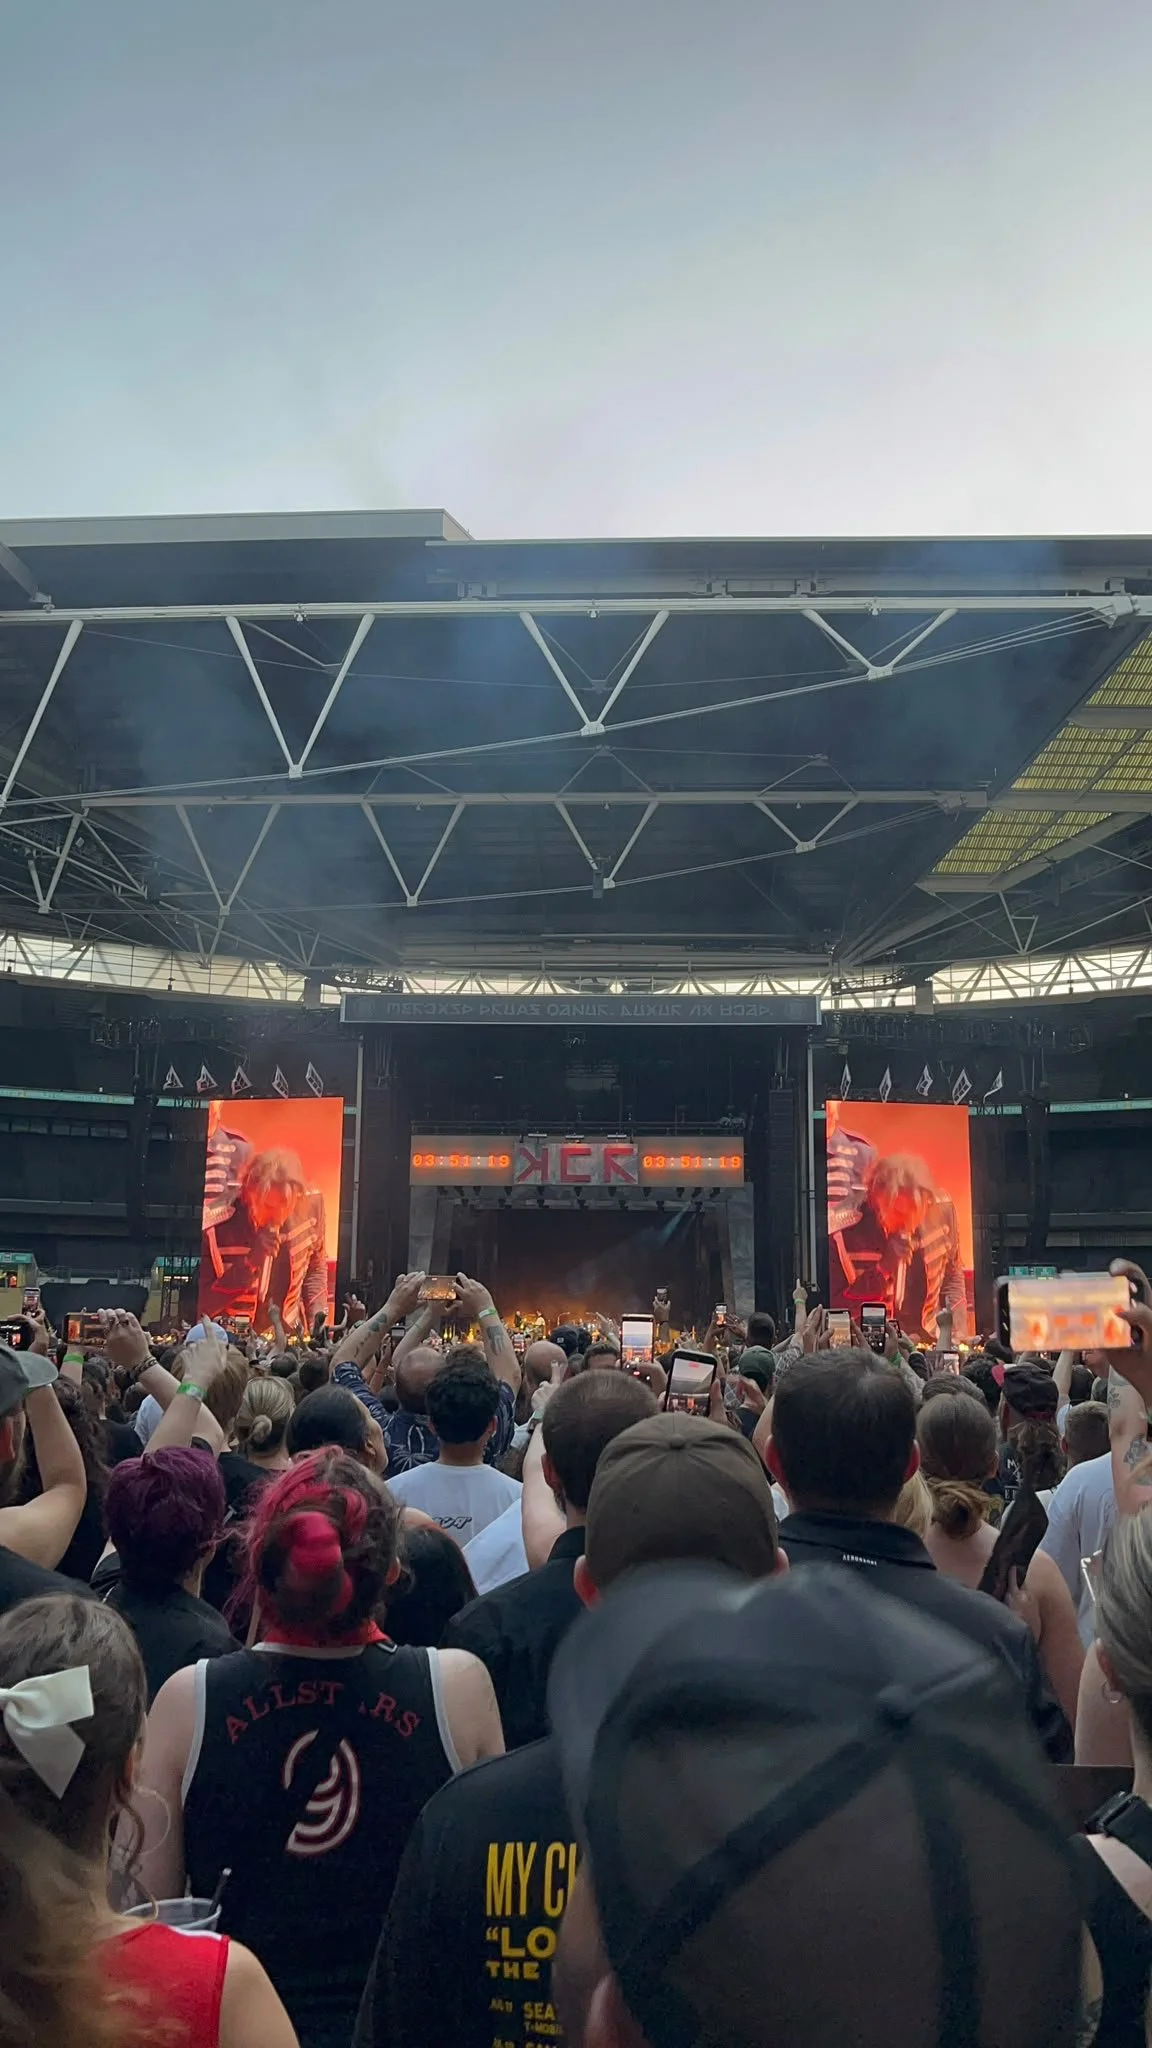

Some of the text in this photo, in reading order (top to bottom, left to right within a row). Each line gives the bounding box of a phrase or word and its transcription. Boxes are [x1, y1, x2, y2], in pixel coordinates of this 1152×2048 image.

[412, 1154, 511, 1168] 03:51:19
[642, 1156, 742, 1169] 03:51:19
[225, 1680, 423, 1744] ALLSTRS
[486, 1841, 537, 1917] MY
[486, 1960, 540, 1979] THE
